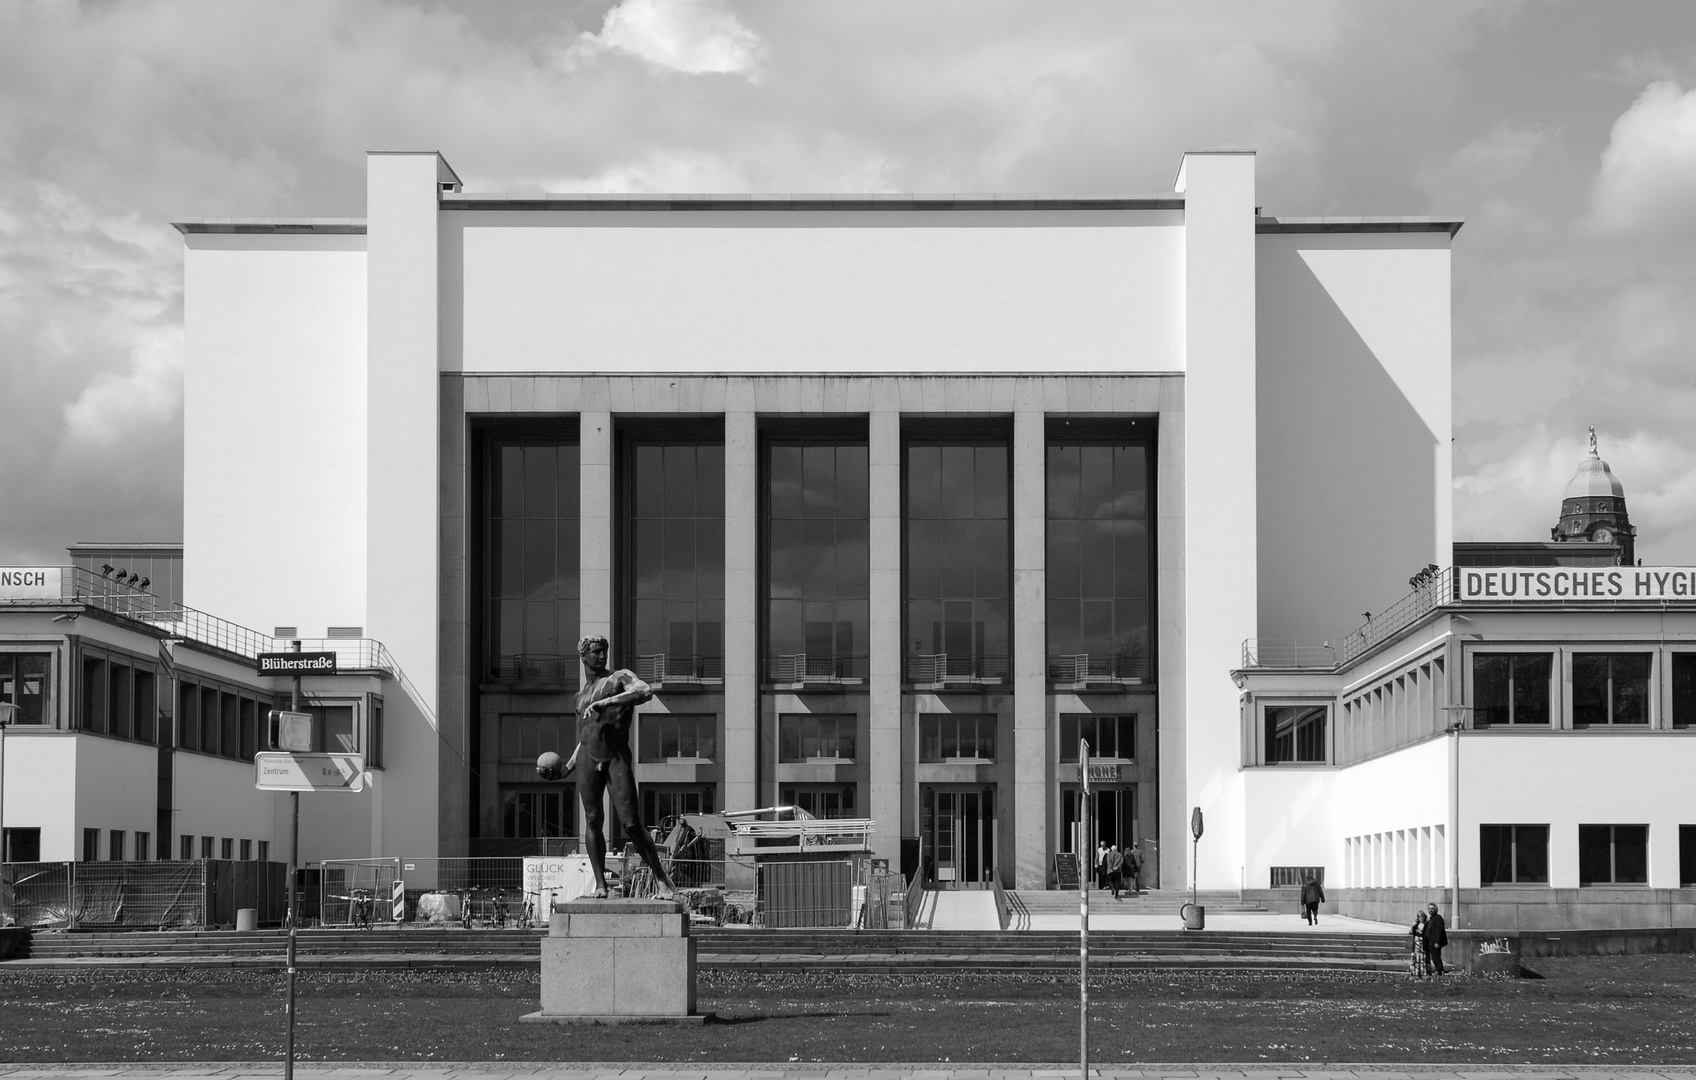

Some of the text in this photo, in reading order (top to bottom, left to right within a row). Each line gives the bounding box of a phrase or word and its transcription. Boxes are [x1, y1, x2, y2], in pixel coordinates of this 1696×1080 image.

[1, 571, 45, 586] NSCH
[1467, 572, 1696, 597] DEUTSCHES HYGI
[261, 656, 333, 670] Blüherstraße
[263, 767, 289, 775] Zentrum
[526, 862, 564, 873] GLÜCK
